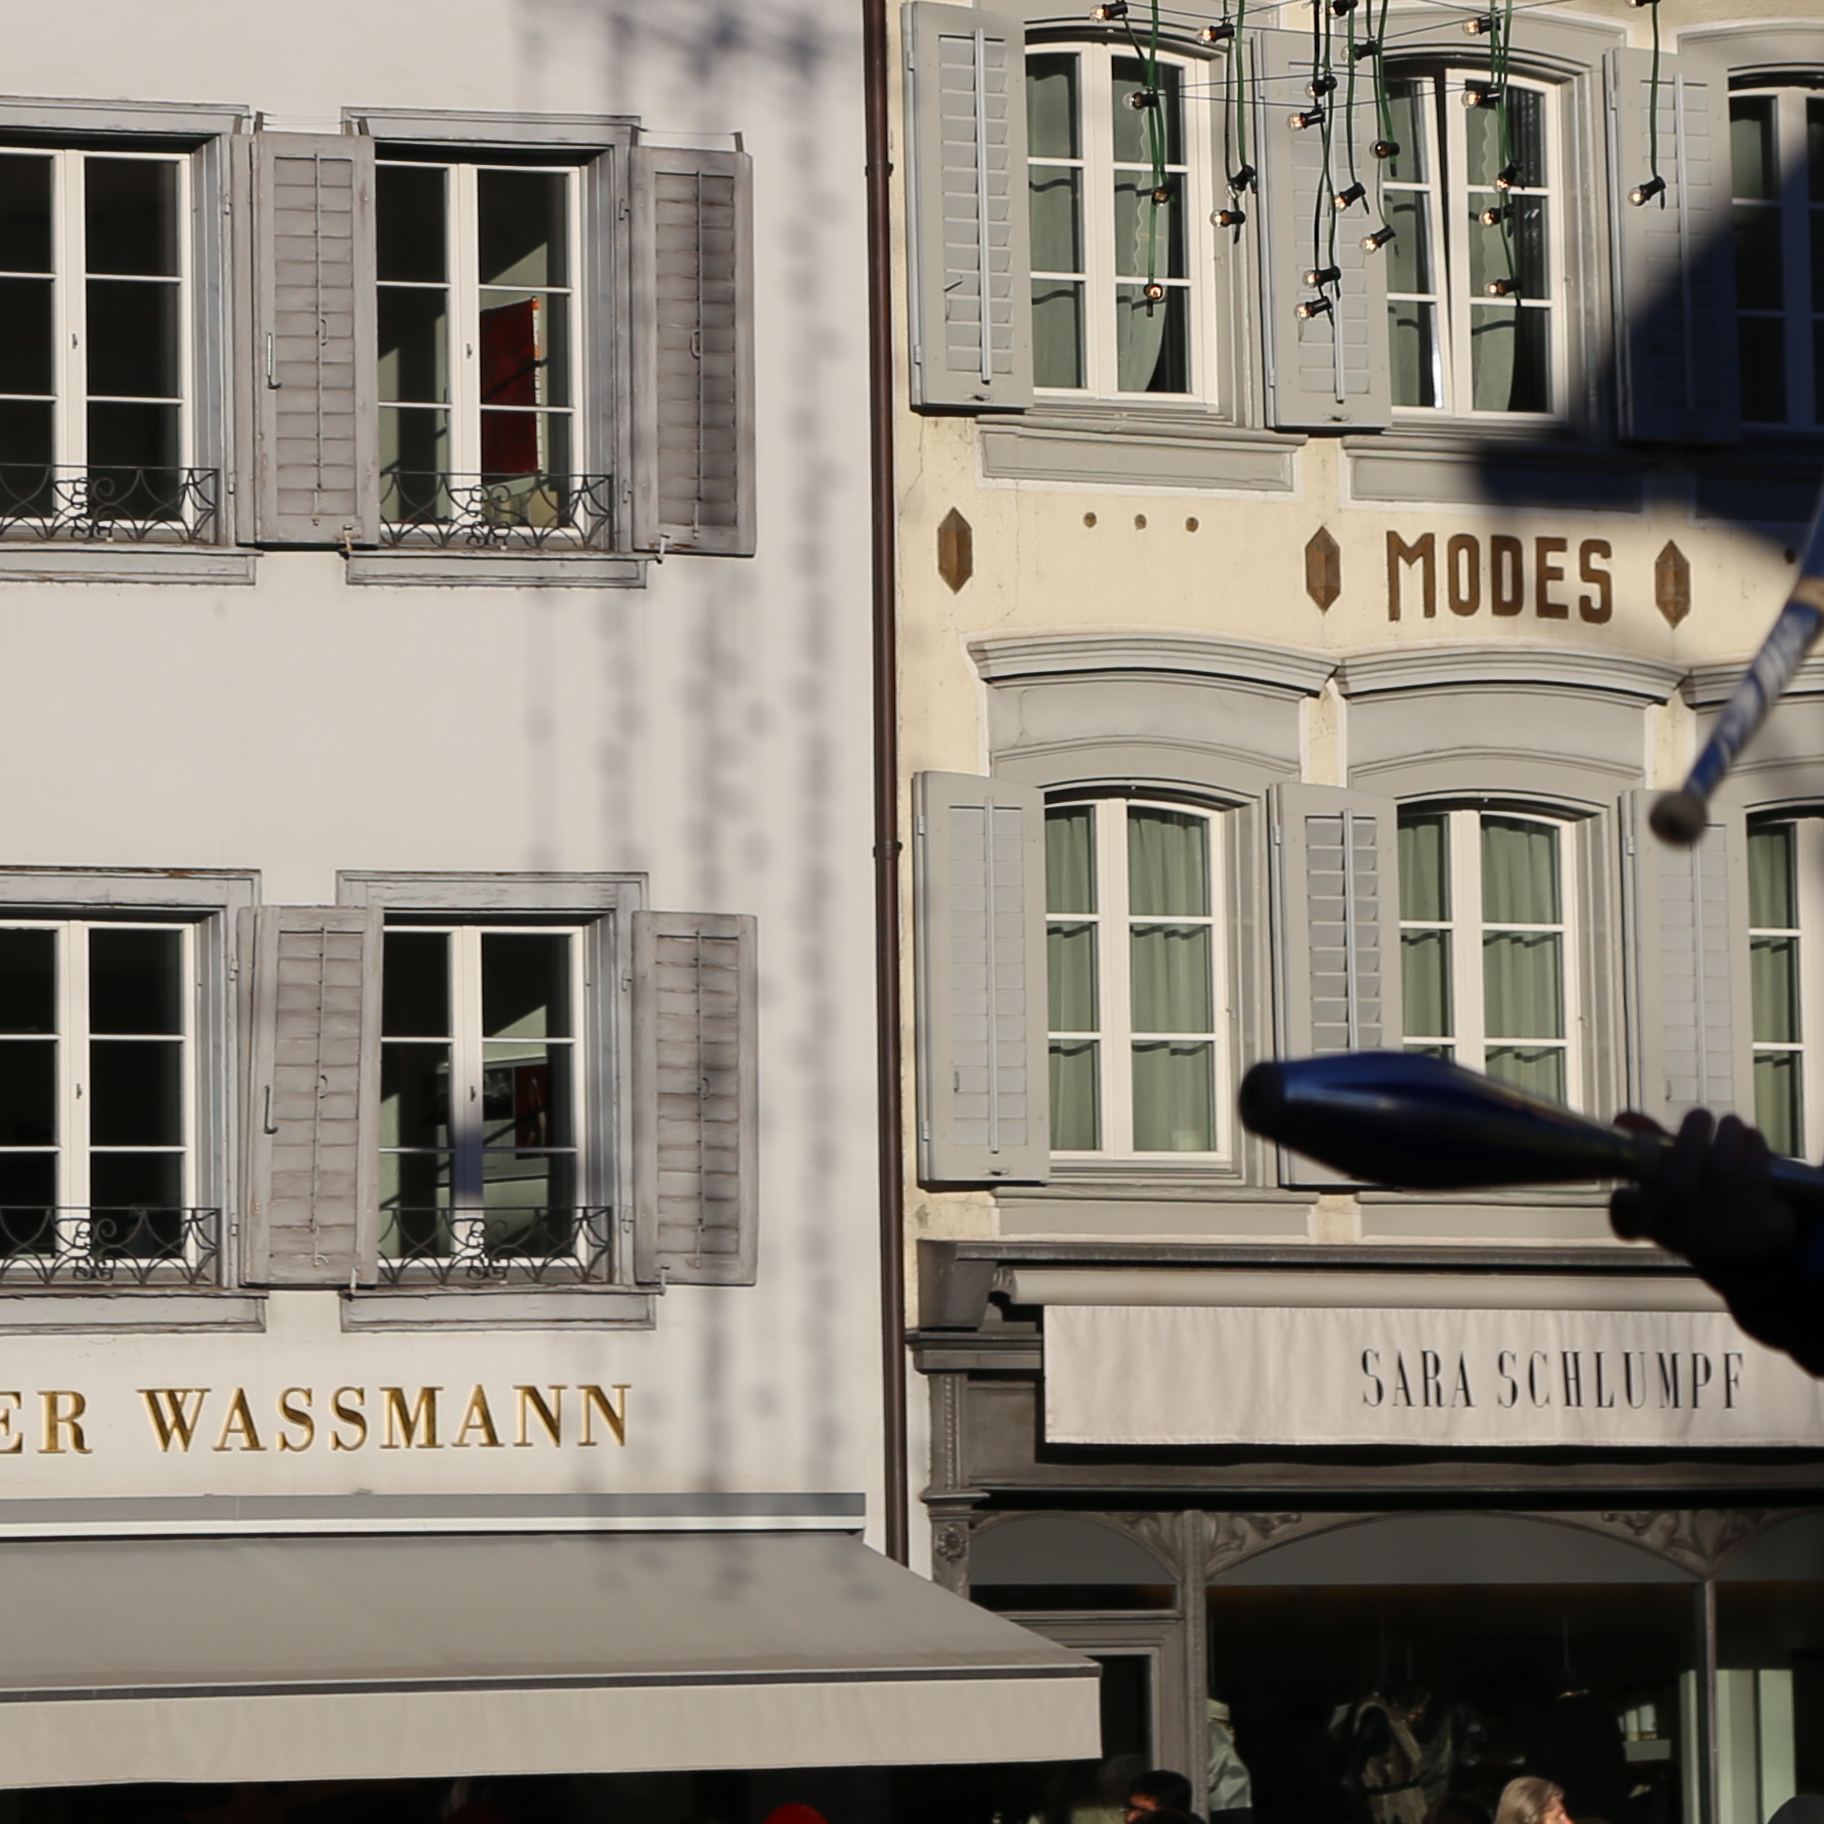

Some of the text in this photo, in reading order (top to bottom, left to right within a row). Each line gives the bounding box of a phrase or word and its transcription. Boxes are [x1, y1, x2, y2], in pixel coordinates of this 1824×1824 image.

[1386, 530, 1613, 625] MODES
[1360, 1348, 1744, 1410] SARA SCHLUMPF
[135, 1383, 633, 1452] WASSMANN
